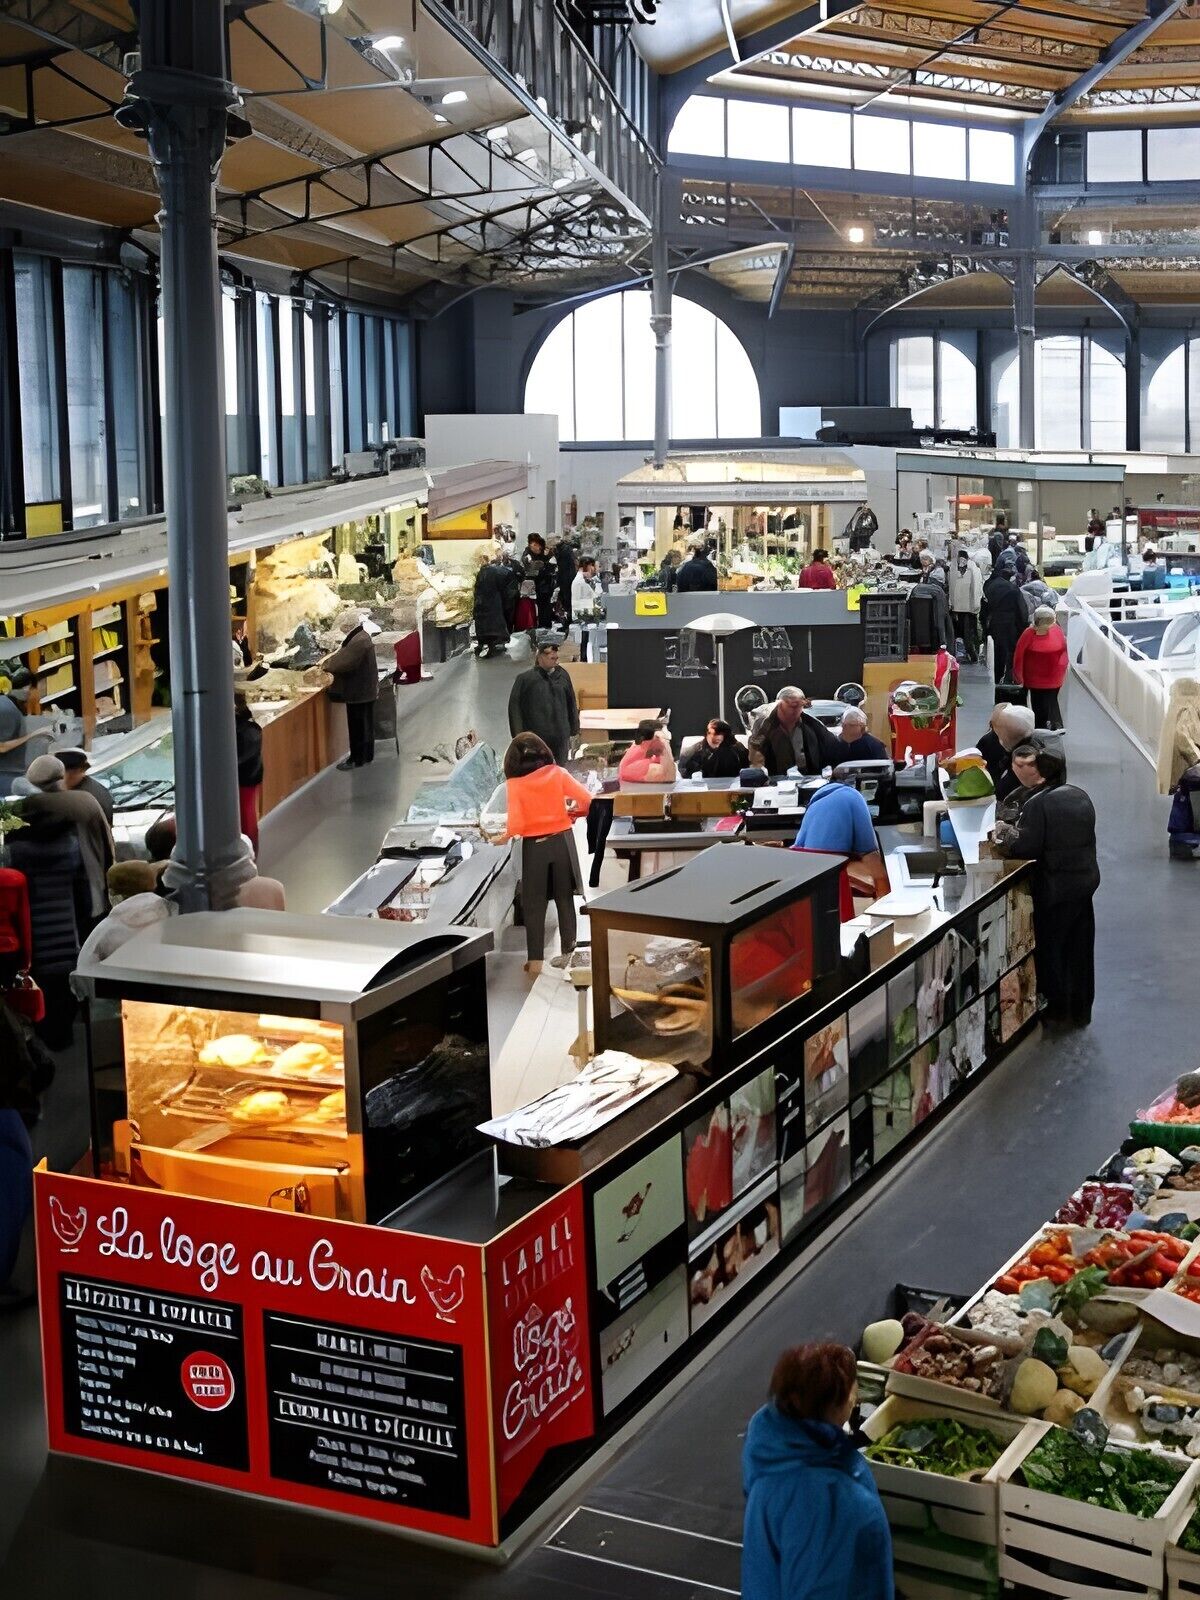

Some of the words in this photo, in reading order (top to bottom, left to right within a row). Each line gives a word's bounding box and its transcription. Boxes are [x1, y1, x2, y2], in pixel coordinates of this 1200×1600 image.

[96, 1206, 153, 1260] La
[160, 1216, 240, 1292] loge
[251, 1250, 303, 1286] au
[308, 1238, 417, 1304] Grain
